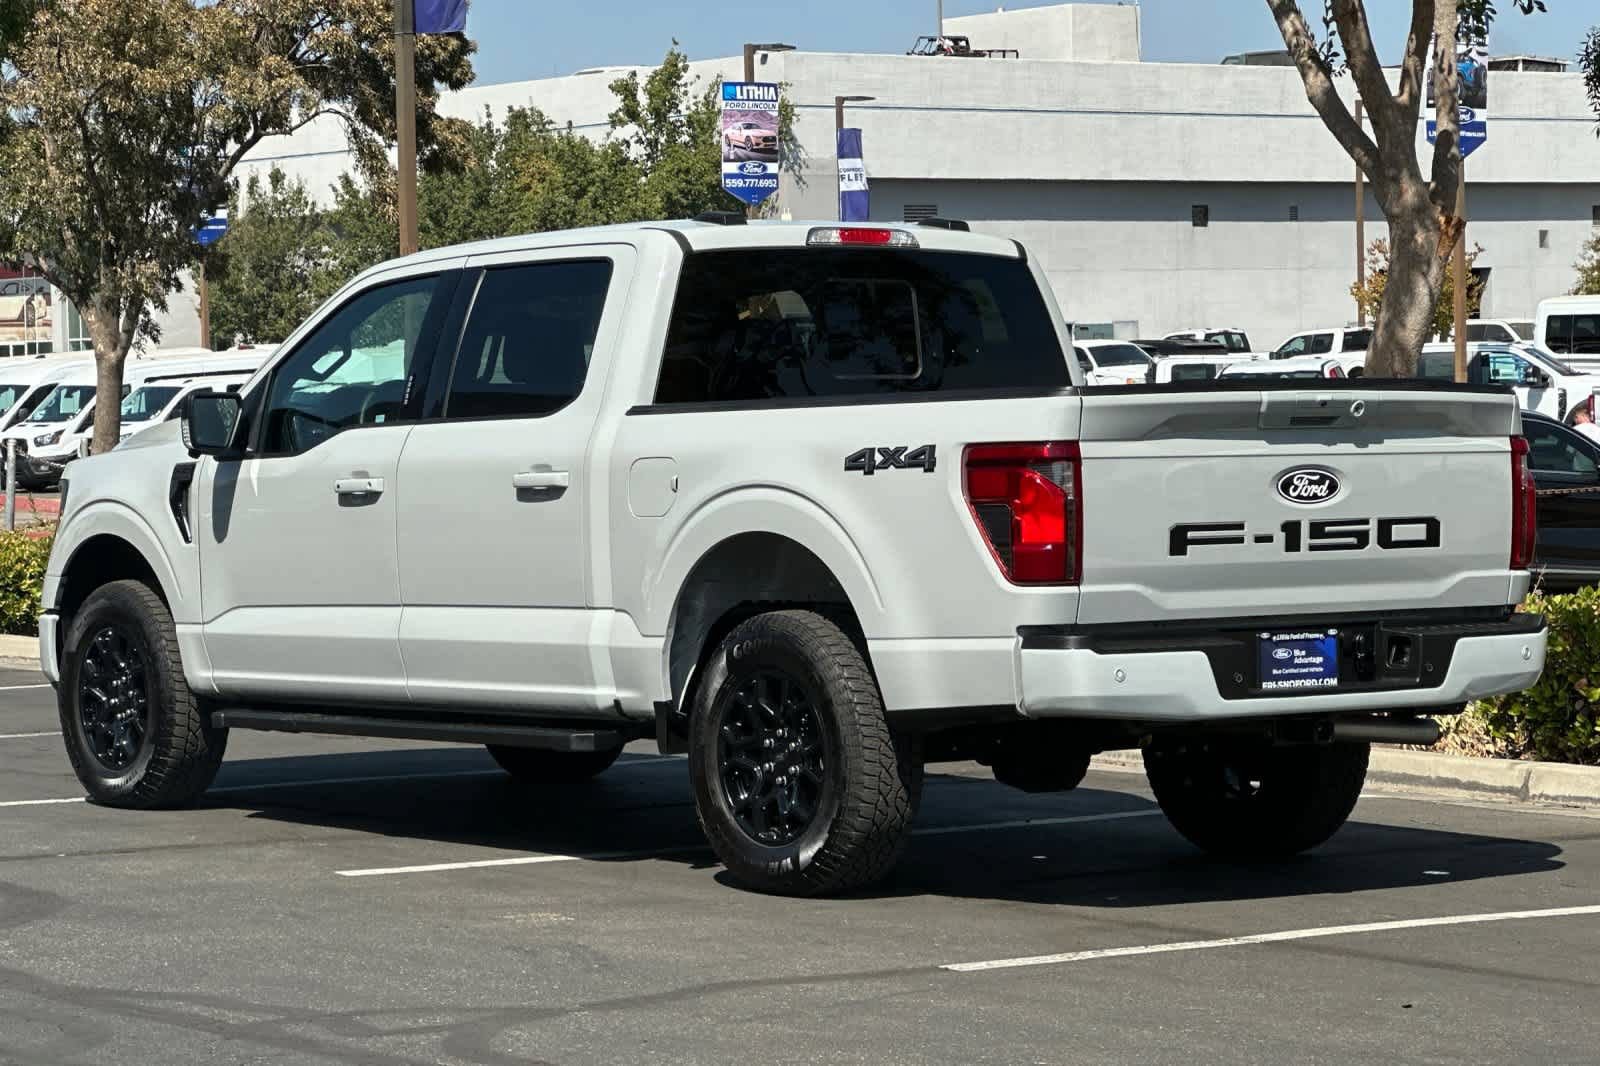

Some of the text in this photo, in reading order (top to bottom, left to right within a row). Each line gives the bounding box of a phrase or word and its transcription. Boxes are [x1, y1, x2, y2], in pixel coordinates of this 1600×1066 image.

[736, 85, 777, 100] LITHIA
[744, 162, 763, 173] Ford
[1289, 473, 1329, 498] Ford
[1169, 515, 1441, 557] F-150
